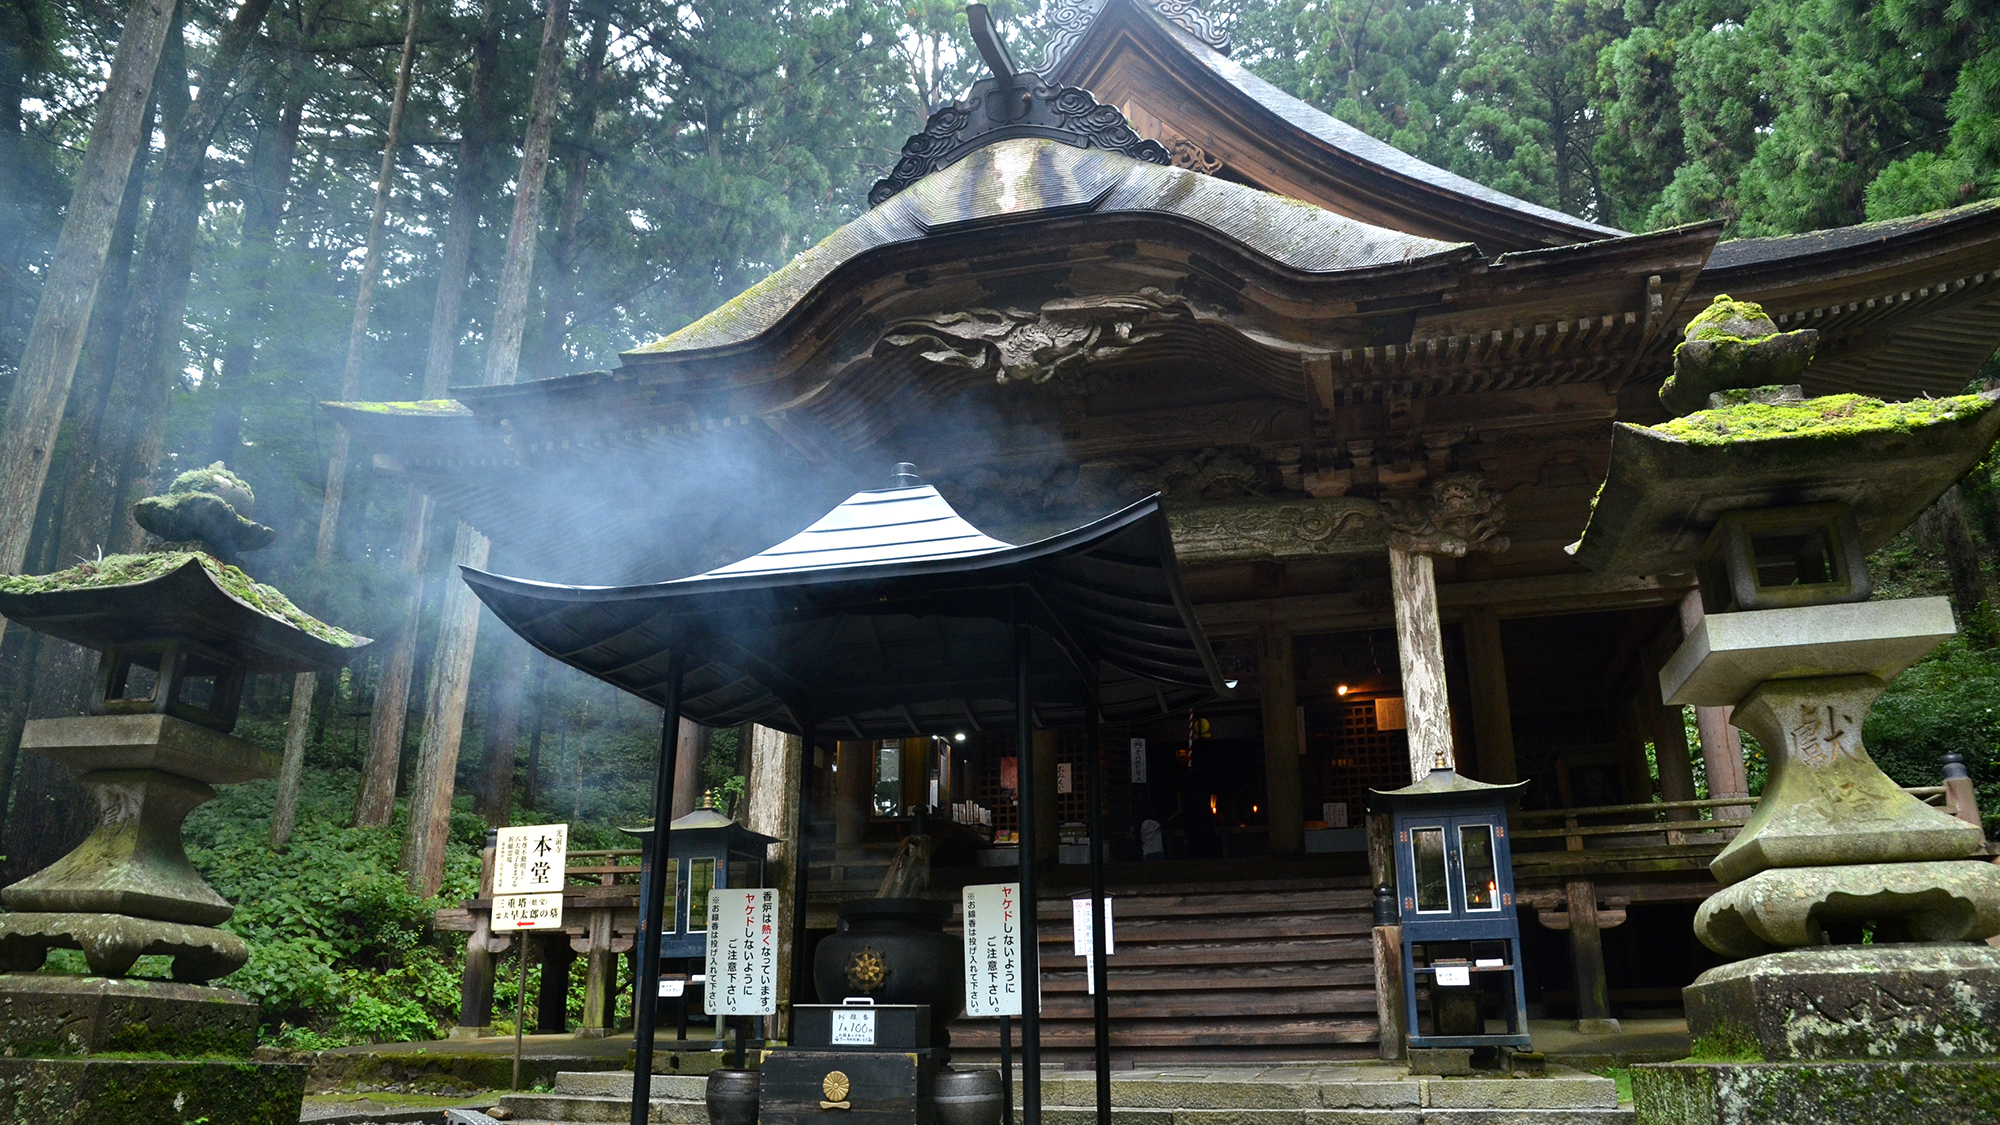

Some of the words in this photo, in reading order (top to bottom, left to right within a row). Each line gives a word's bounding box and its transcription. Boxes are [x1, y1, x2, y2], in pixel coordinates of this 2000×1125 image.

[530, 835, 553, 885] 本堂
[726, 938, 738, 1012] ご注意下さい。
[743, 893, 756, 996] ヤケドしないように
[760, 891, 772, 1013] 香炉は熱くなっています。
[987, 936, 1000, 1013] ご注意下さい。
[1002, 886, 1016, 994] ヤケドしないように
